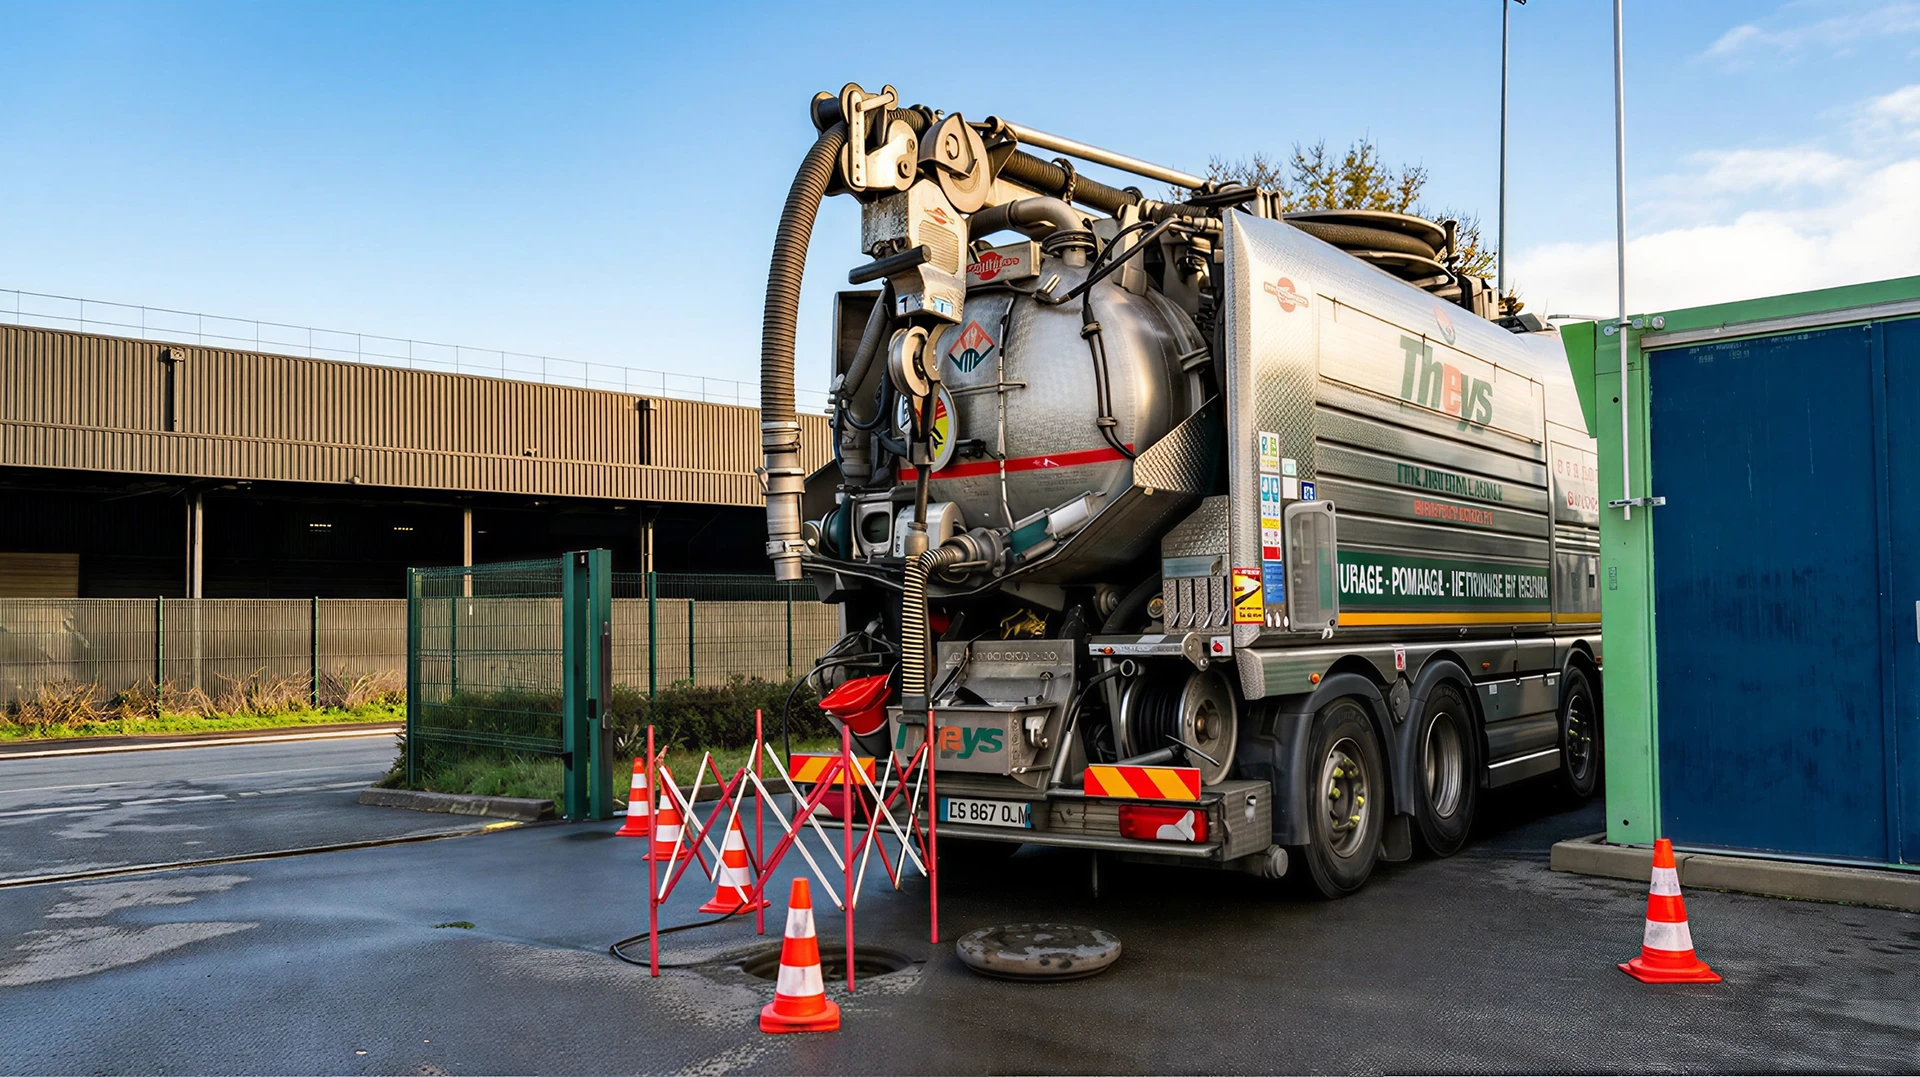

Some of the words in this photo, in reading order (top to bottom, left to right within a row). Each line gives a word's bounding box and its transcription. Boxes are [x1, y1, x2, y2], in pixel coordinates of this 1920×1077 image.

[1400, 335, 1493, 432] Theys
[1337, 563, 1383, 594] URAGE
[970, 803, 996, 821] 867
